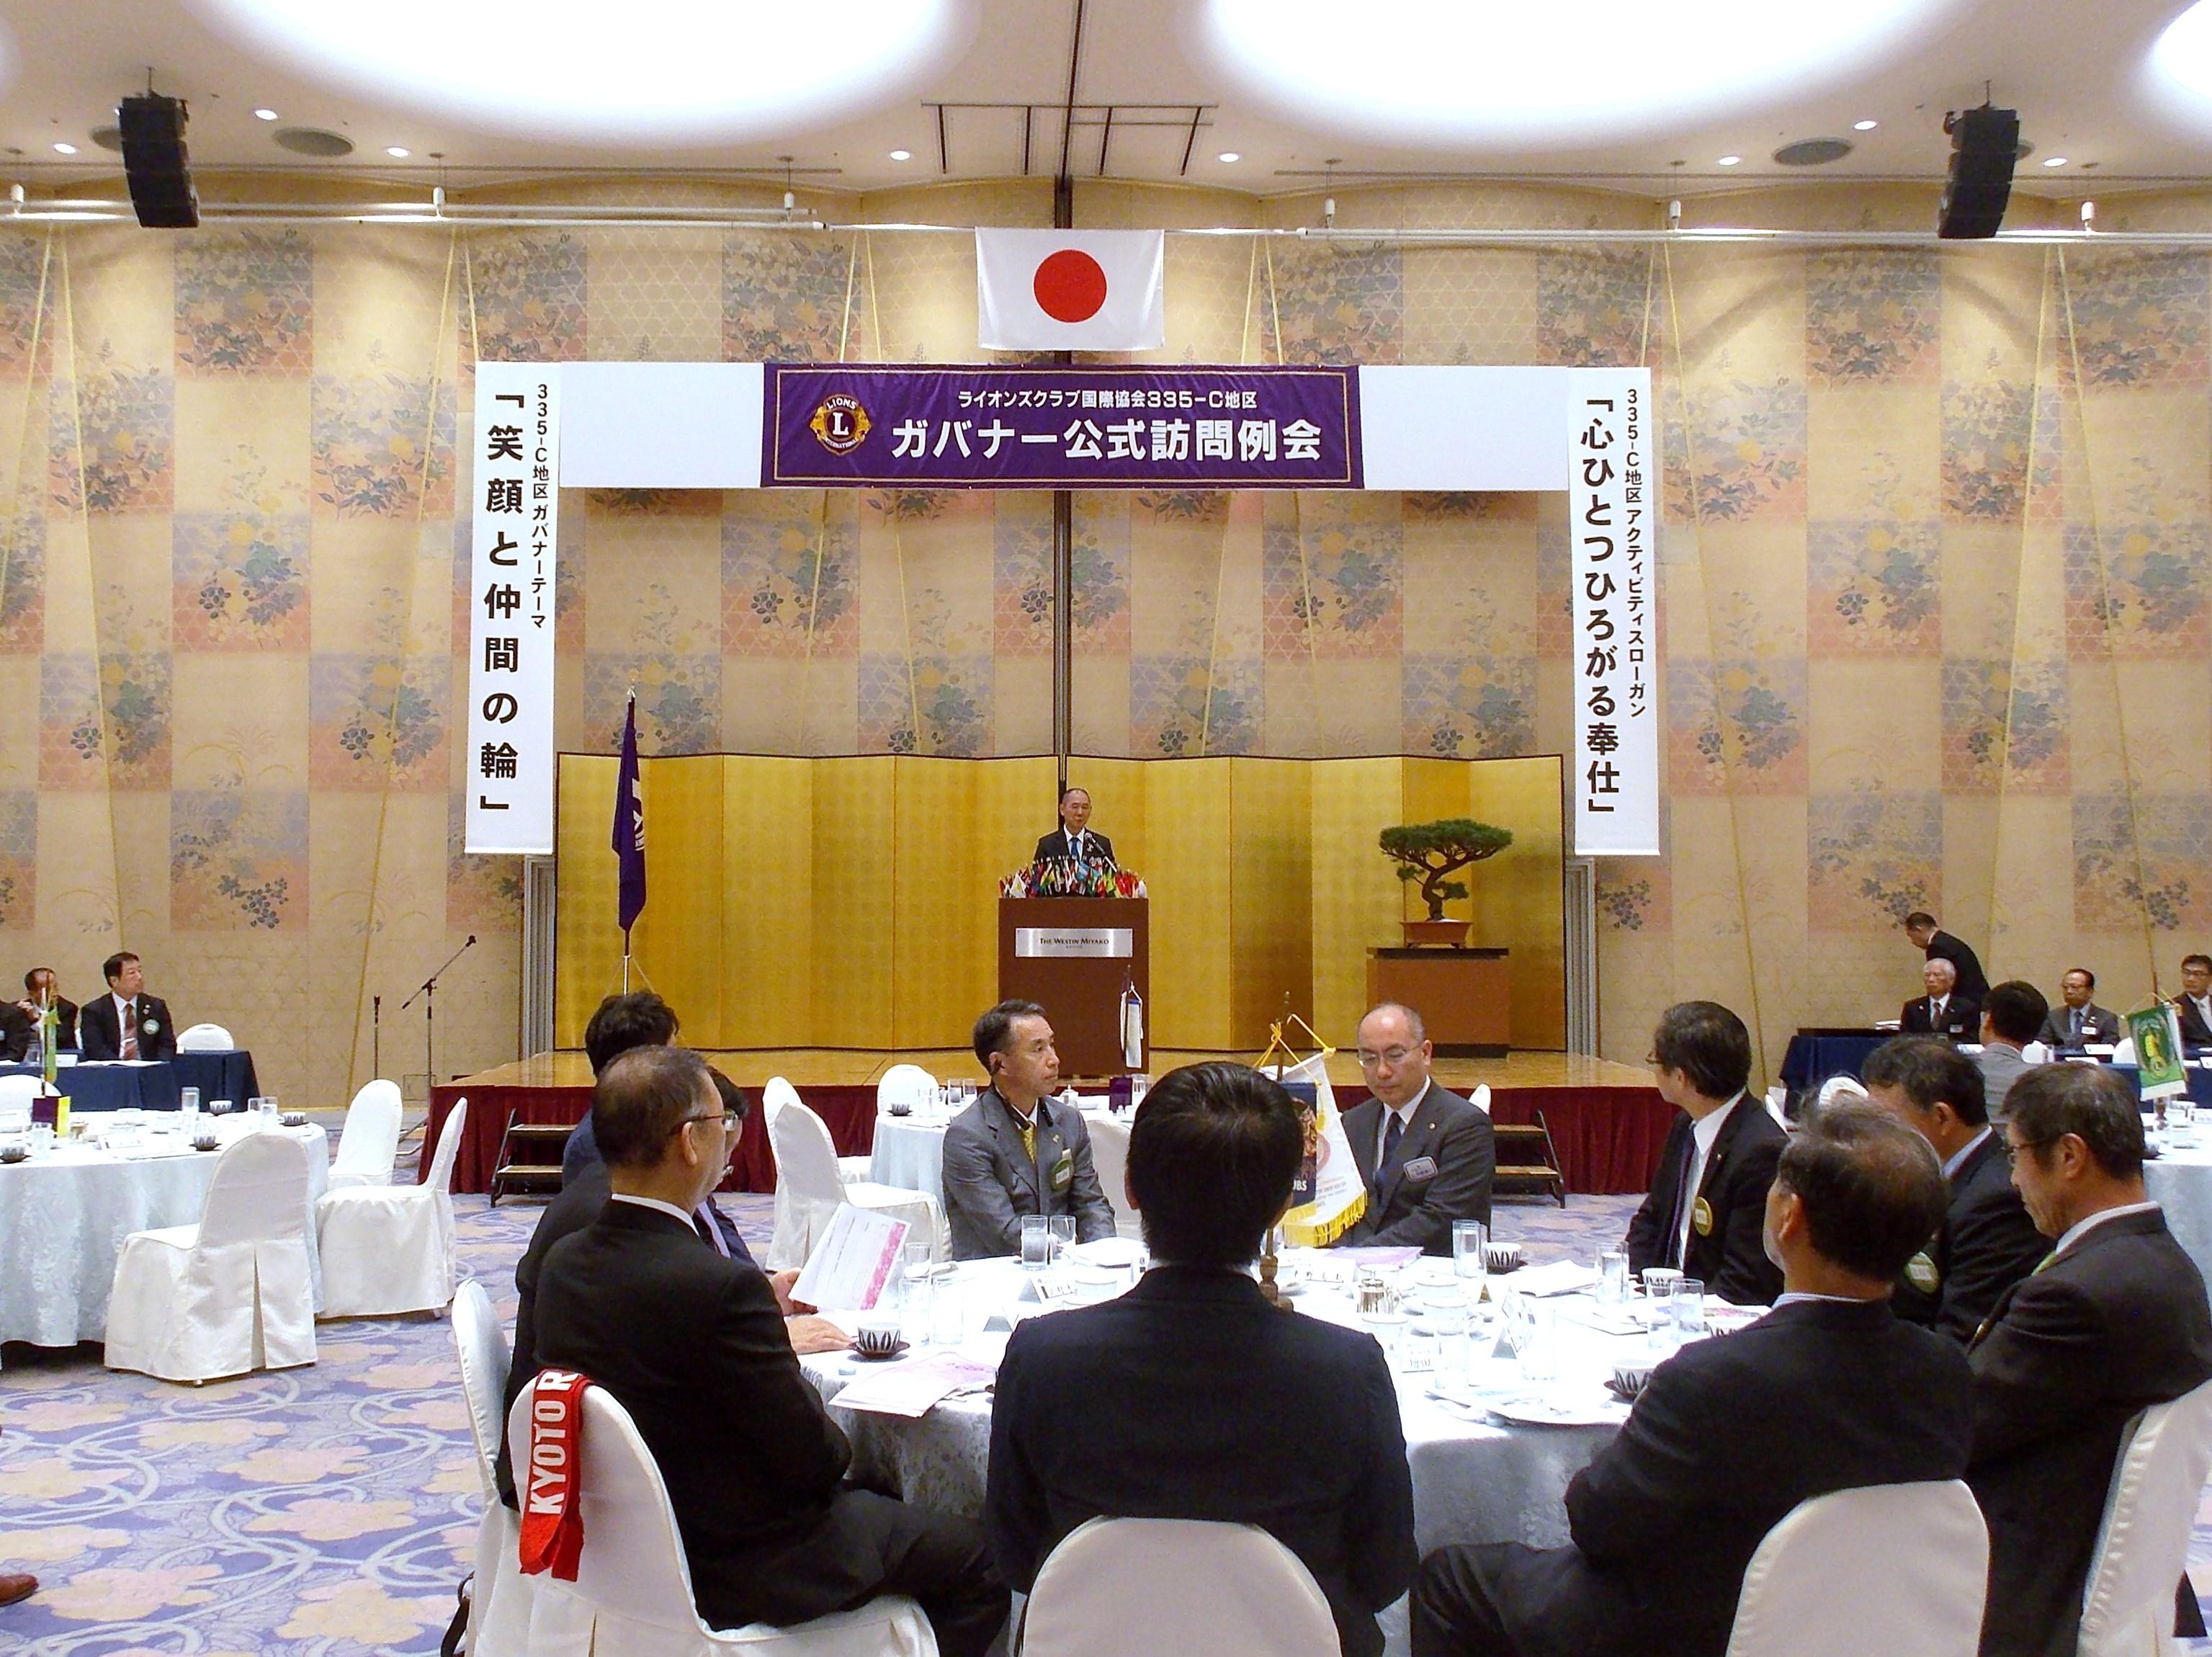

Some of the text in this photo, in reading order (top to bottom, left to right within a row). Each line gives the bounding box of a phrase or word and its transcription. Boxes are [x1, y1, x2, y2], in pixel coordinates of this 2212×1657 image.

[825, 398, 857, 410] LIONS
[833, 412, 849, 435] L
[892, 418, 1322, 462] ガバナー公式訪問例会
[480, 395, 524, 810] 「笑顔と仲間の輪」
[1580, 399, 1620, 813] 「心ひとつひろがる奉仕」
[529, 1400, 566, 1514] KYOTO
